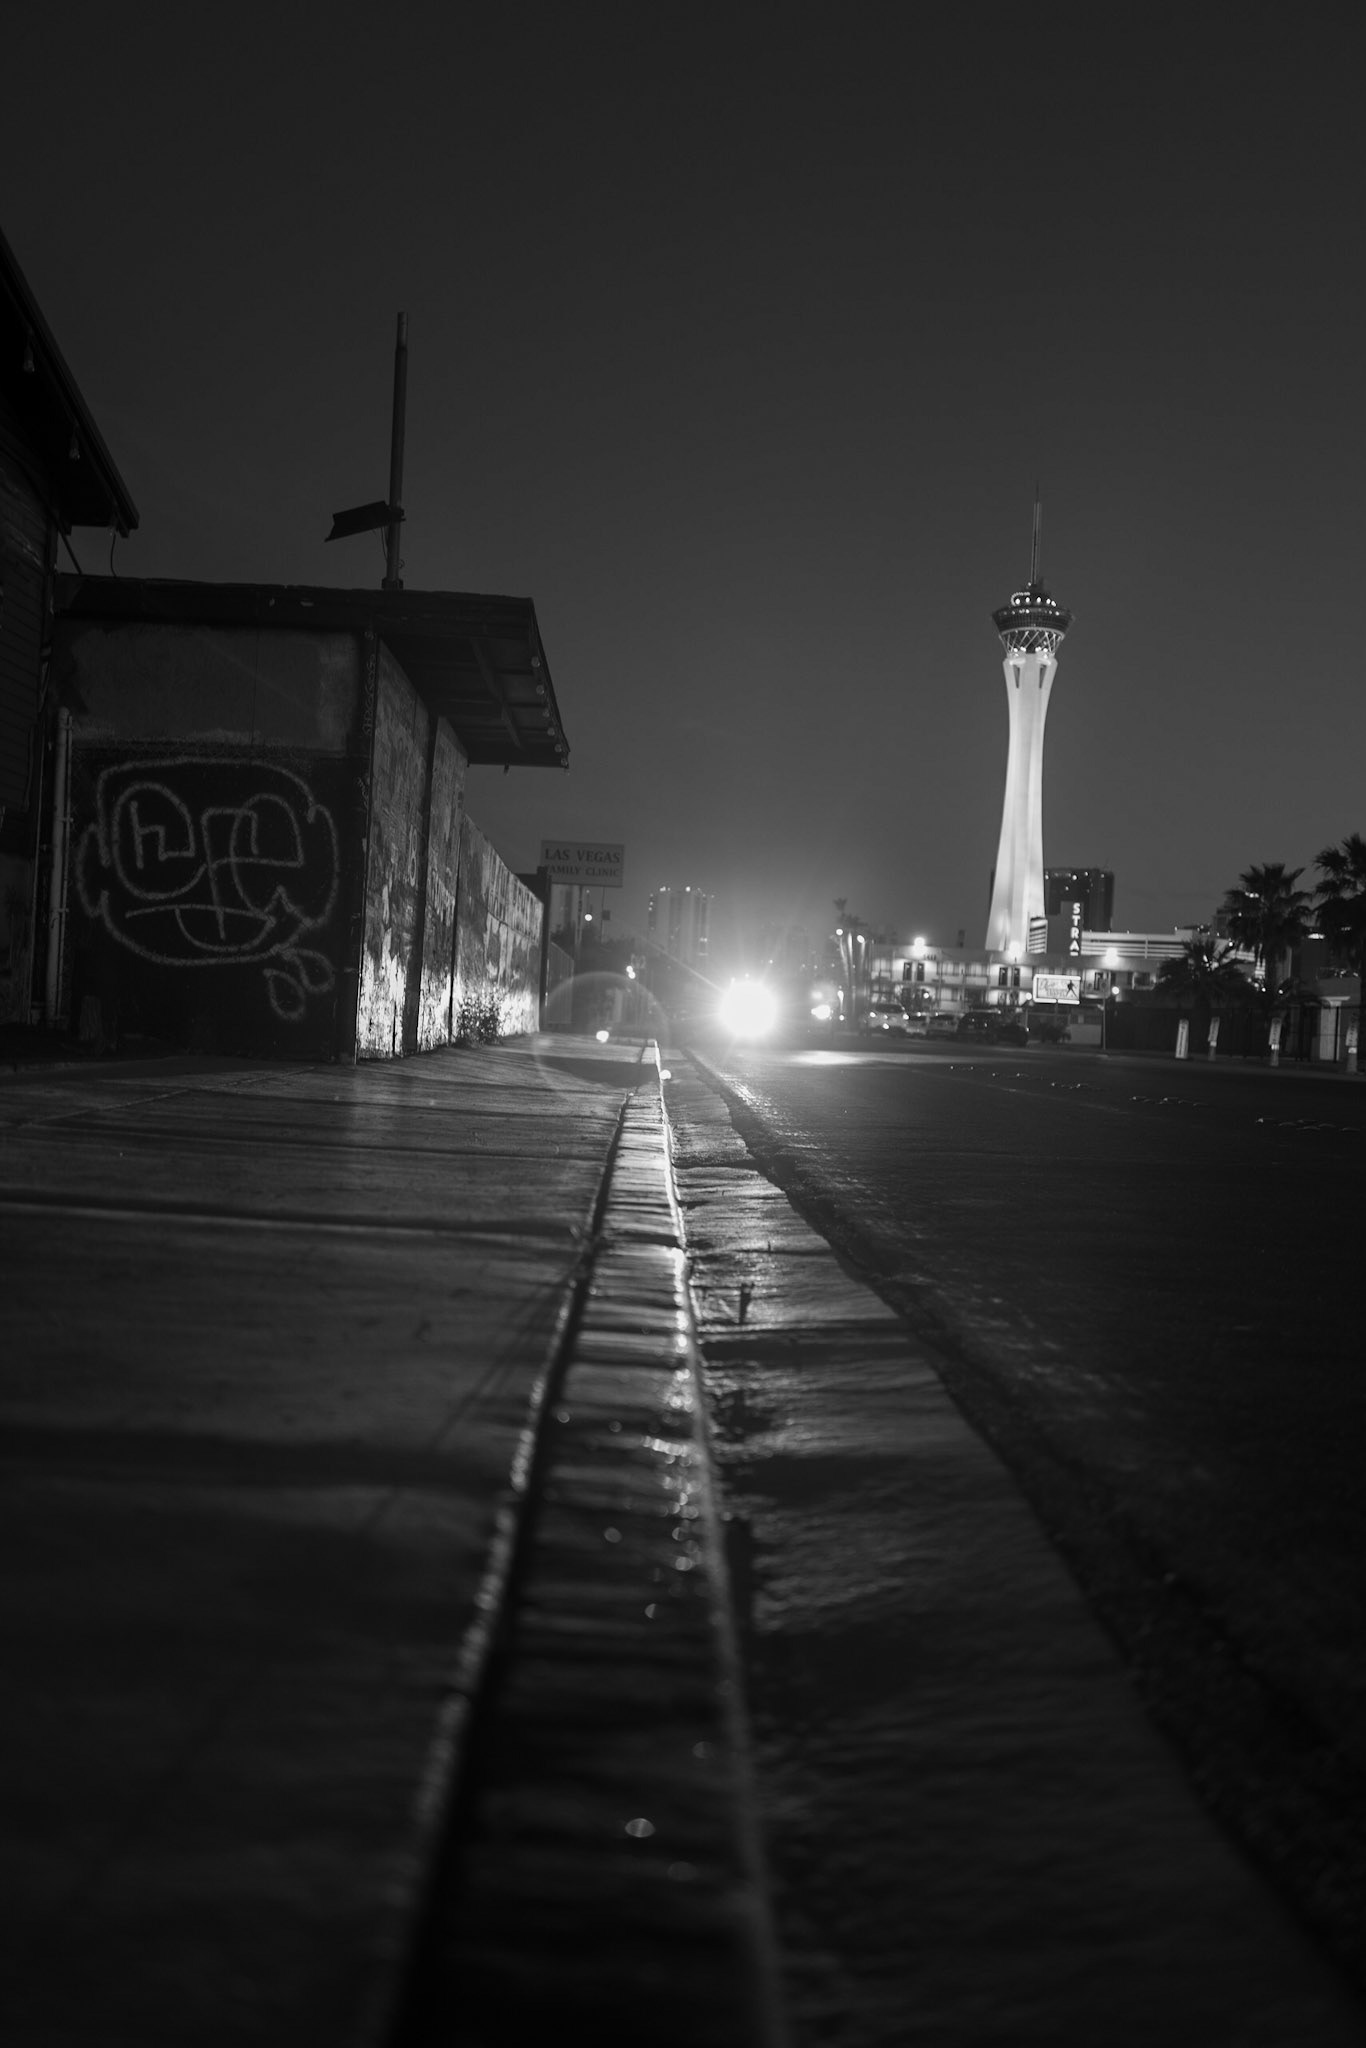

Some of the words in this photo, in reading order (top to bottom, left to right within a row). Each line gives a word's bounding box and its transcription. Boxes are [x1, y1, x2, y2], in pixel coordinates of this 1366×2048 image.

[545, 848, 570, 861] LAS
[577, 850, 620, 864] VEGAS
[585, 867, 620, 878] CLINIC
